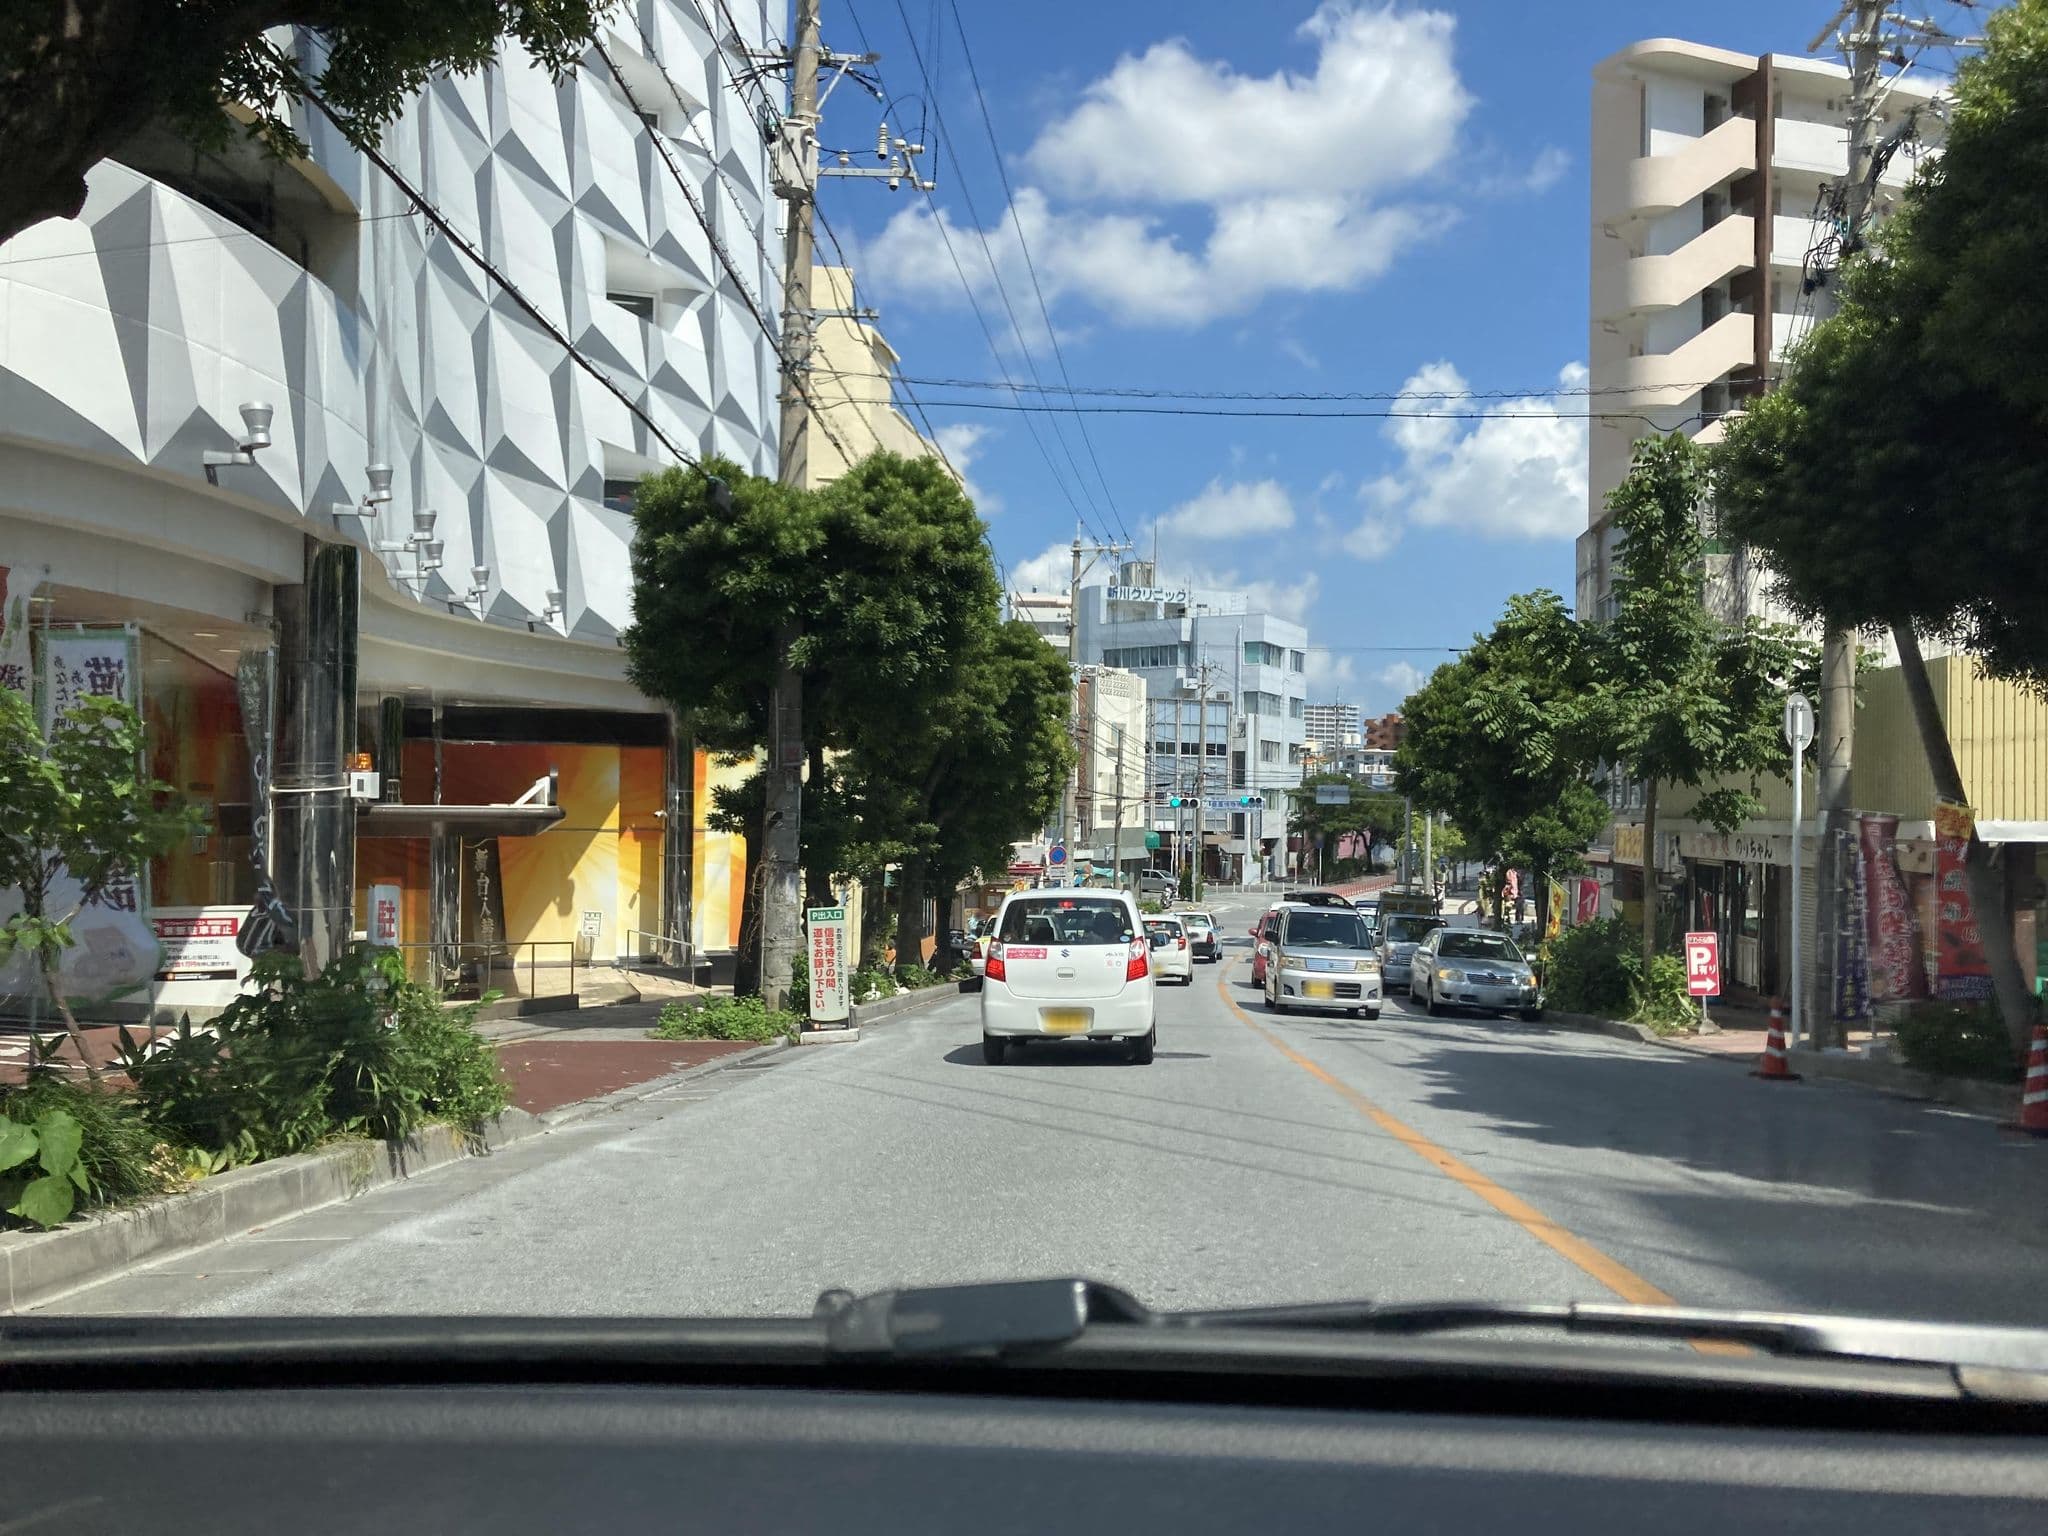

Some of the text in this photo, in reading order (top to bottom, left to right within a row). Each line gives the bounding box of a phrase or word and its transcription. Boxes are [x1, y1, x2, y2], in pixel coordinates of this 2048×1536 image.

[1107, 585, 1186, 602] 新川クリニック
[1735, 837, 1773, 860] のりちゃん
